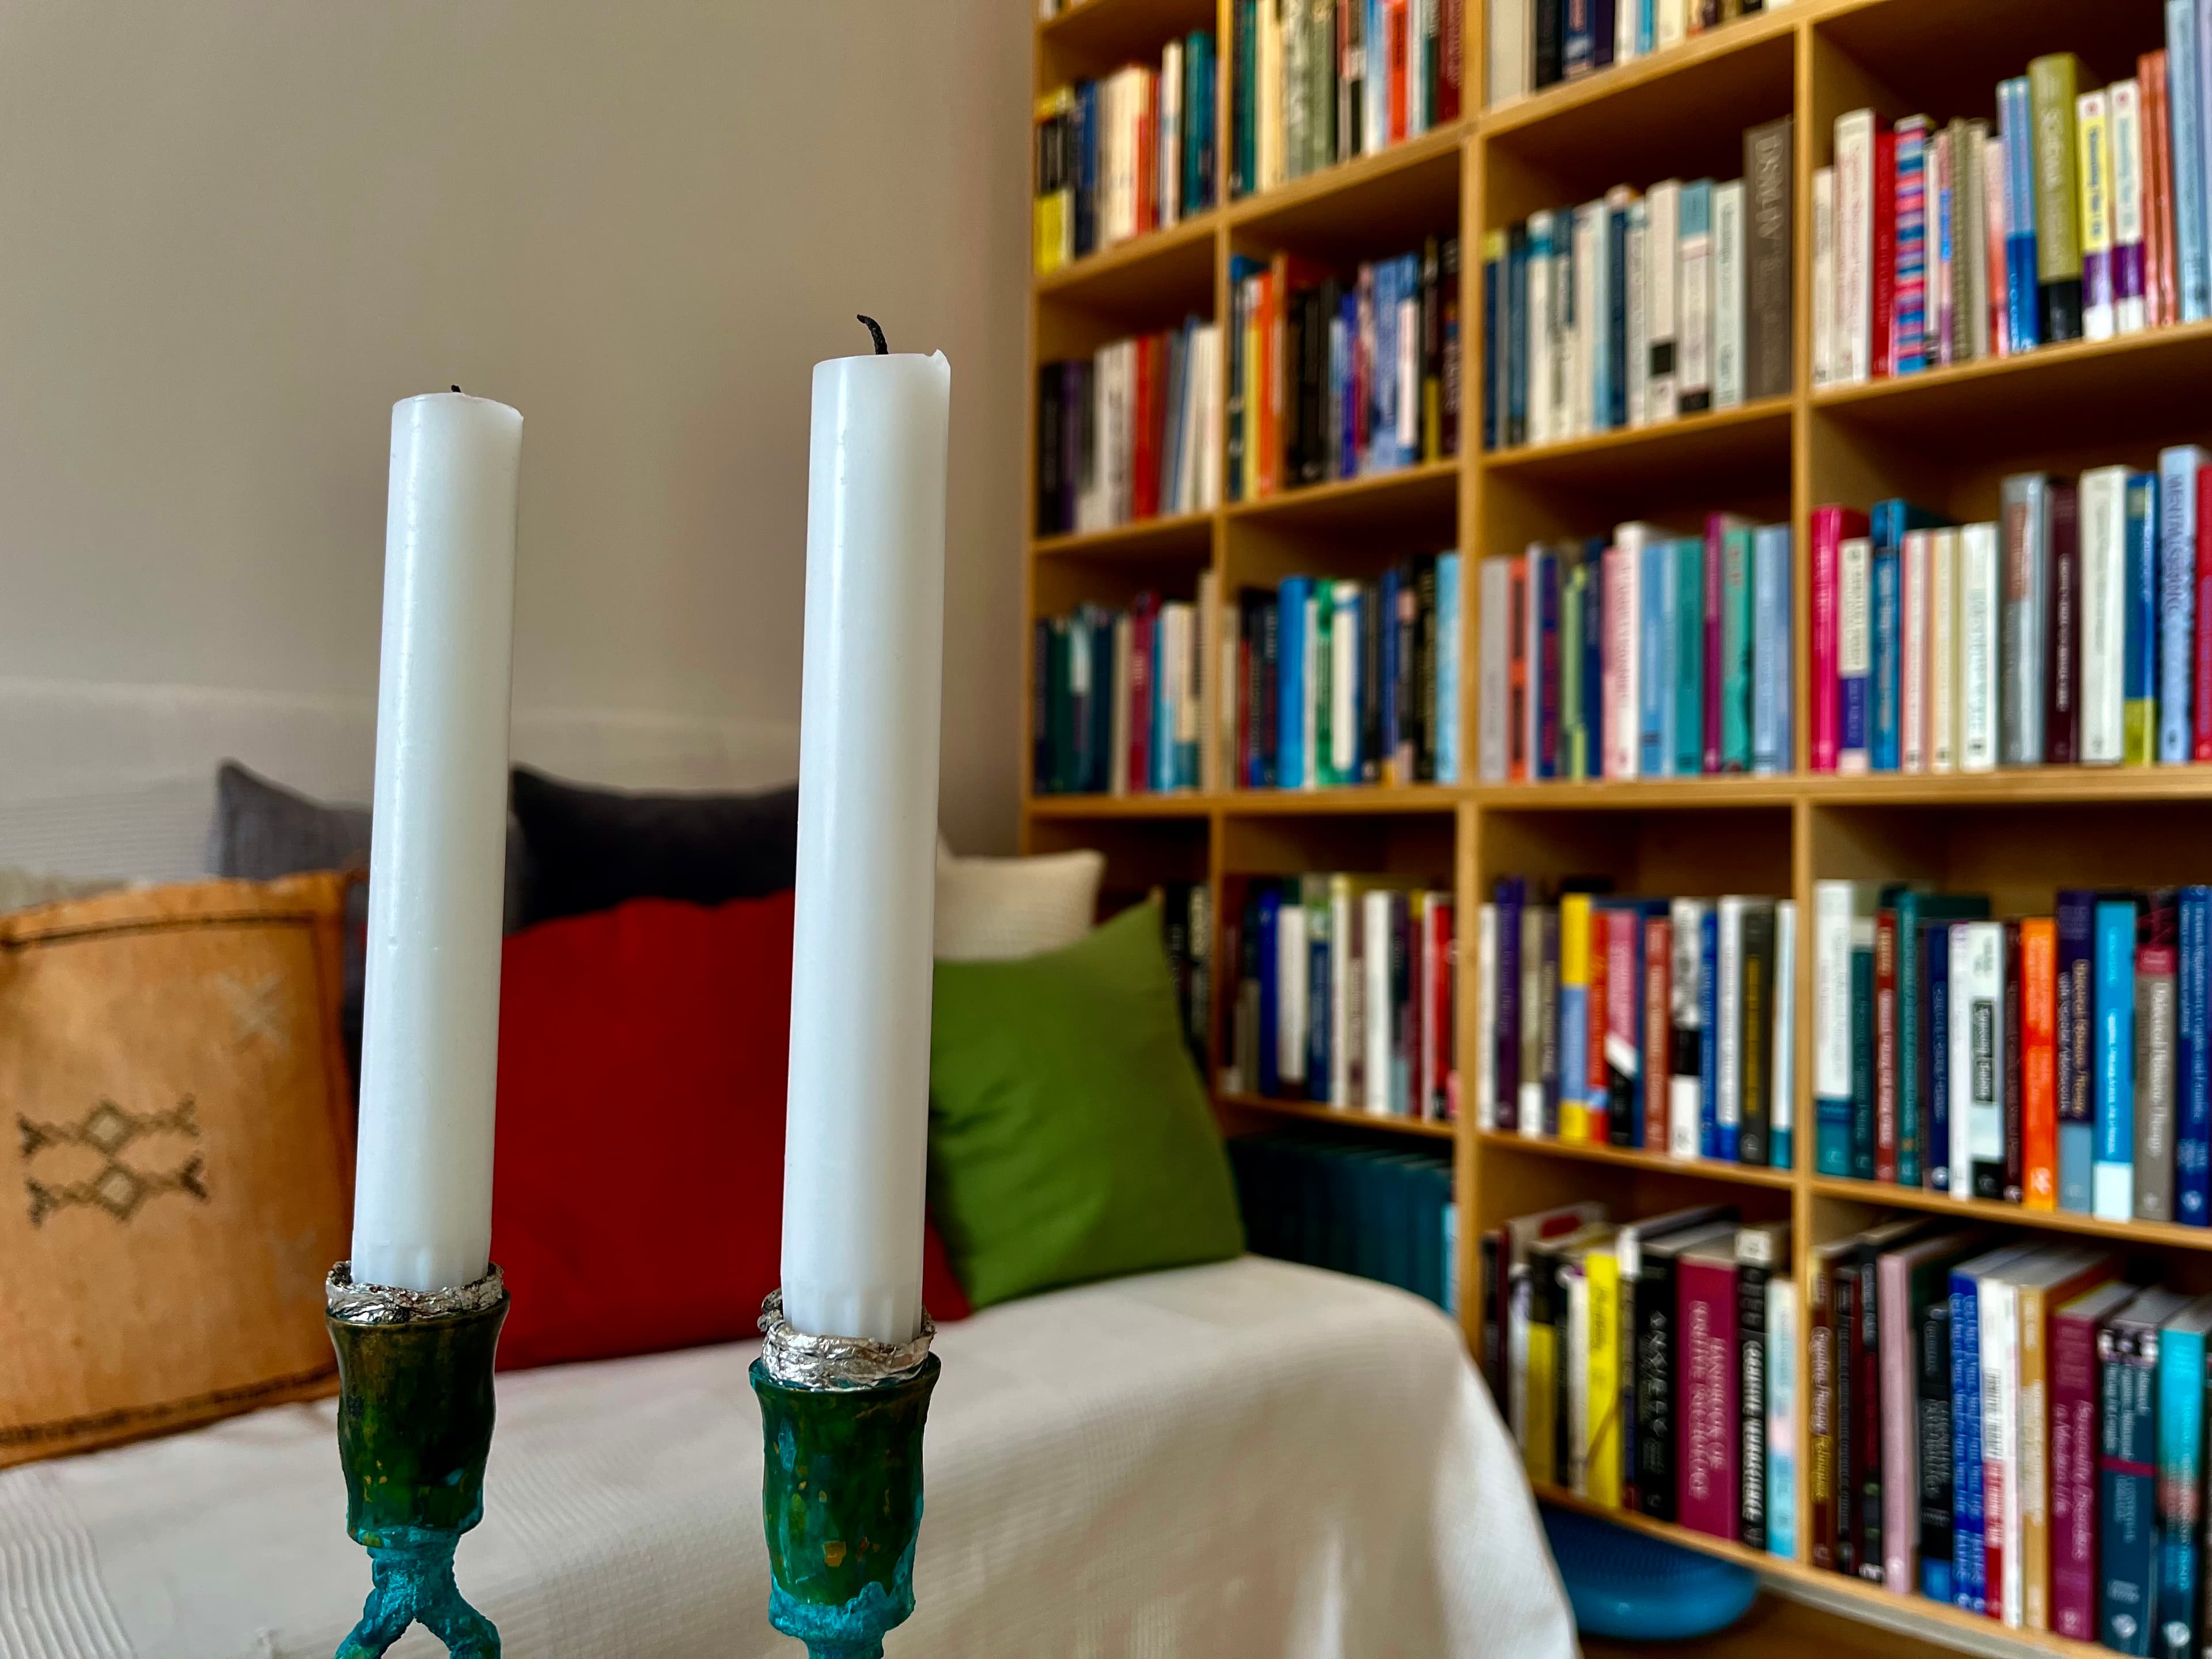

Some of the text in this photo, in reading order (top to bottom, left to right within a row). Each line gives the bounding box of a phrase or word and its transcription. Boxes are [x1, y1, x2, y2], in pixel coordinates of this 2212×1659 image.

[1755, 135, 1783, 240] DSM-IV
[2072, 960, 2090, 1019] Dialectical
[2072, 1019, 2090, 1070] Behavior
[2147, 983, 2170, 1157] Dialectical Behavior Therapy
[2072, 1071, 2090, 1118] Therapy
[1810, 1327, 1831, 1502] Cognitive Therapy Techniques
